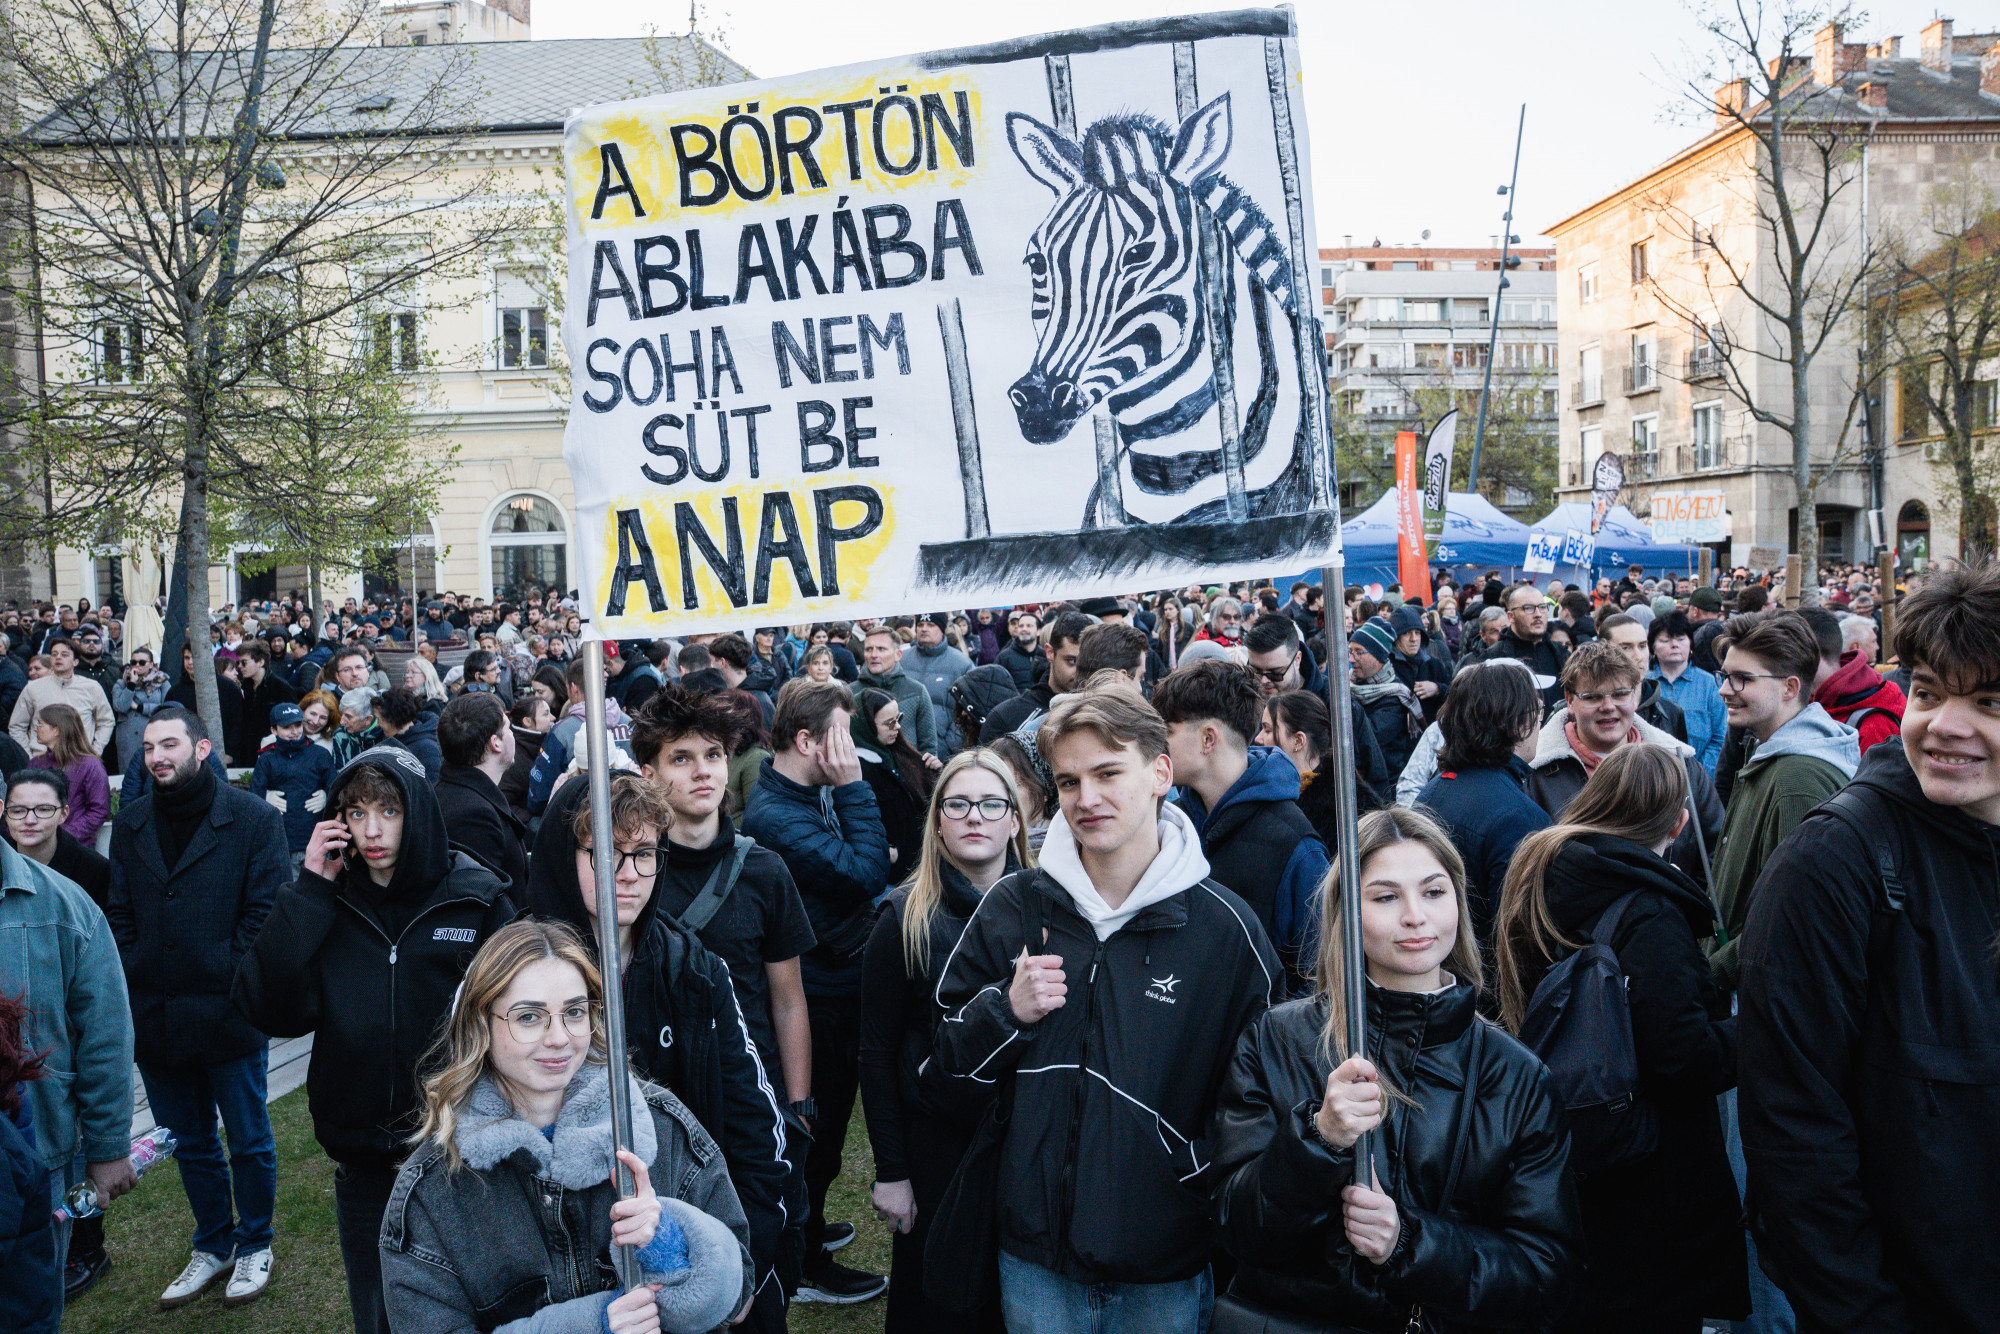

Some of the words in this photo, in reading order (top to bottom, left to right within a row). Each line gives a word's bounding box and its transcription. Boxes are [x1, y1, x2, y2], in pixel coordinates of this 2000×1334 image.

[591, 143, 646, 219] A
[670, 84, 975, 208] BÖRTÖN
[587, 196, 984, 327] ABLAKÁBA
[582, 325, 744, 413] SOHA
[772, 312, 911, 388] NEM
[640, 401, 772, 485] SÜT
[797, 396, 879, 473] BE
[1531, 537, 1558, 562] TÁBLA
[1567, 535, 1593, 565] BÉKA
[1651, 494, 1727, 521] INGYEN
